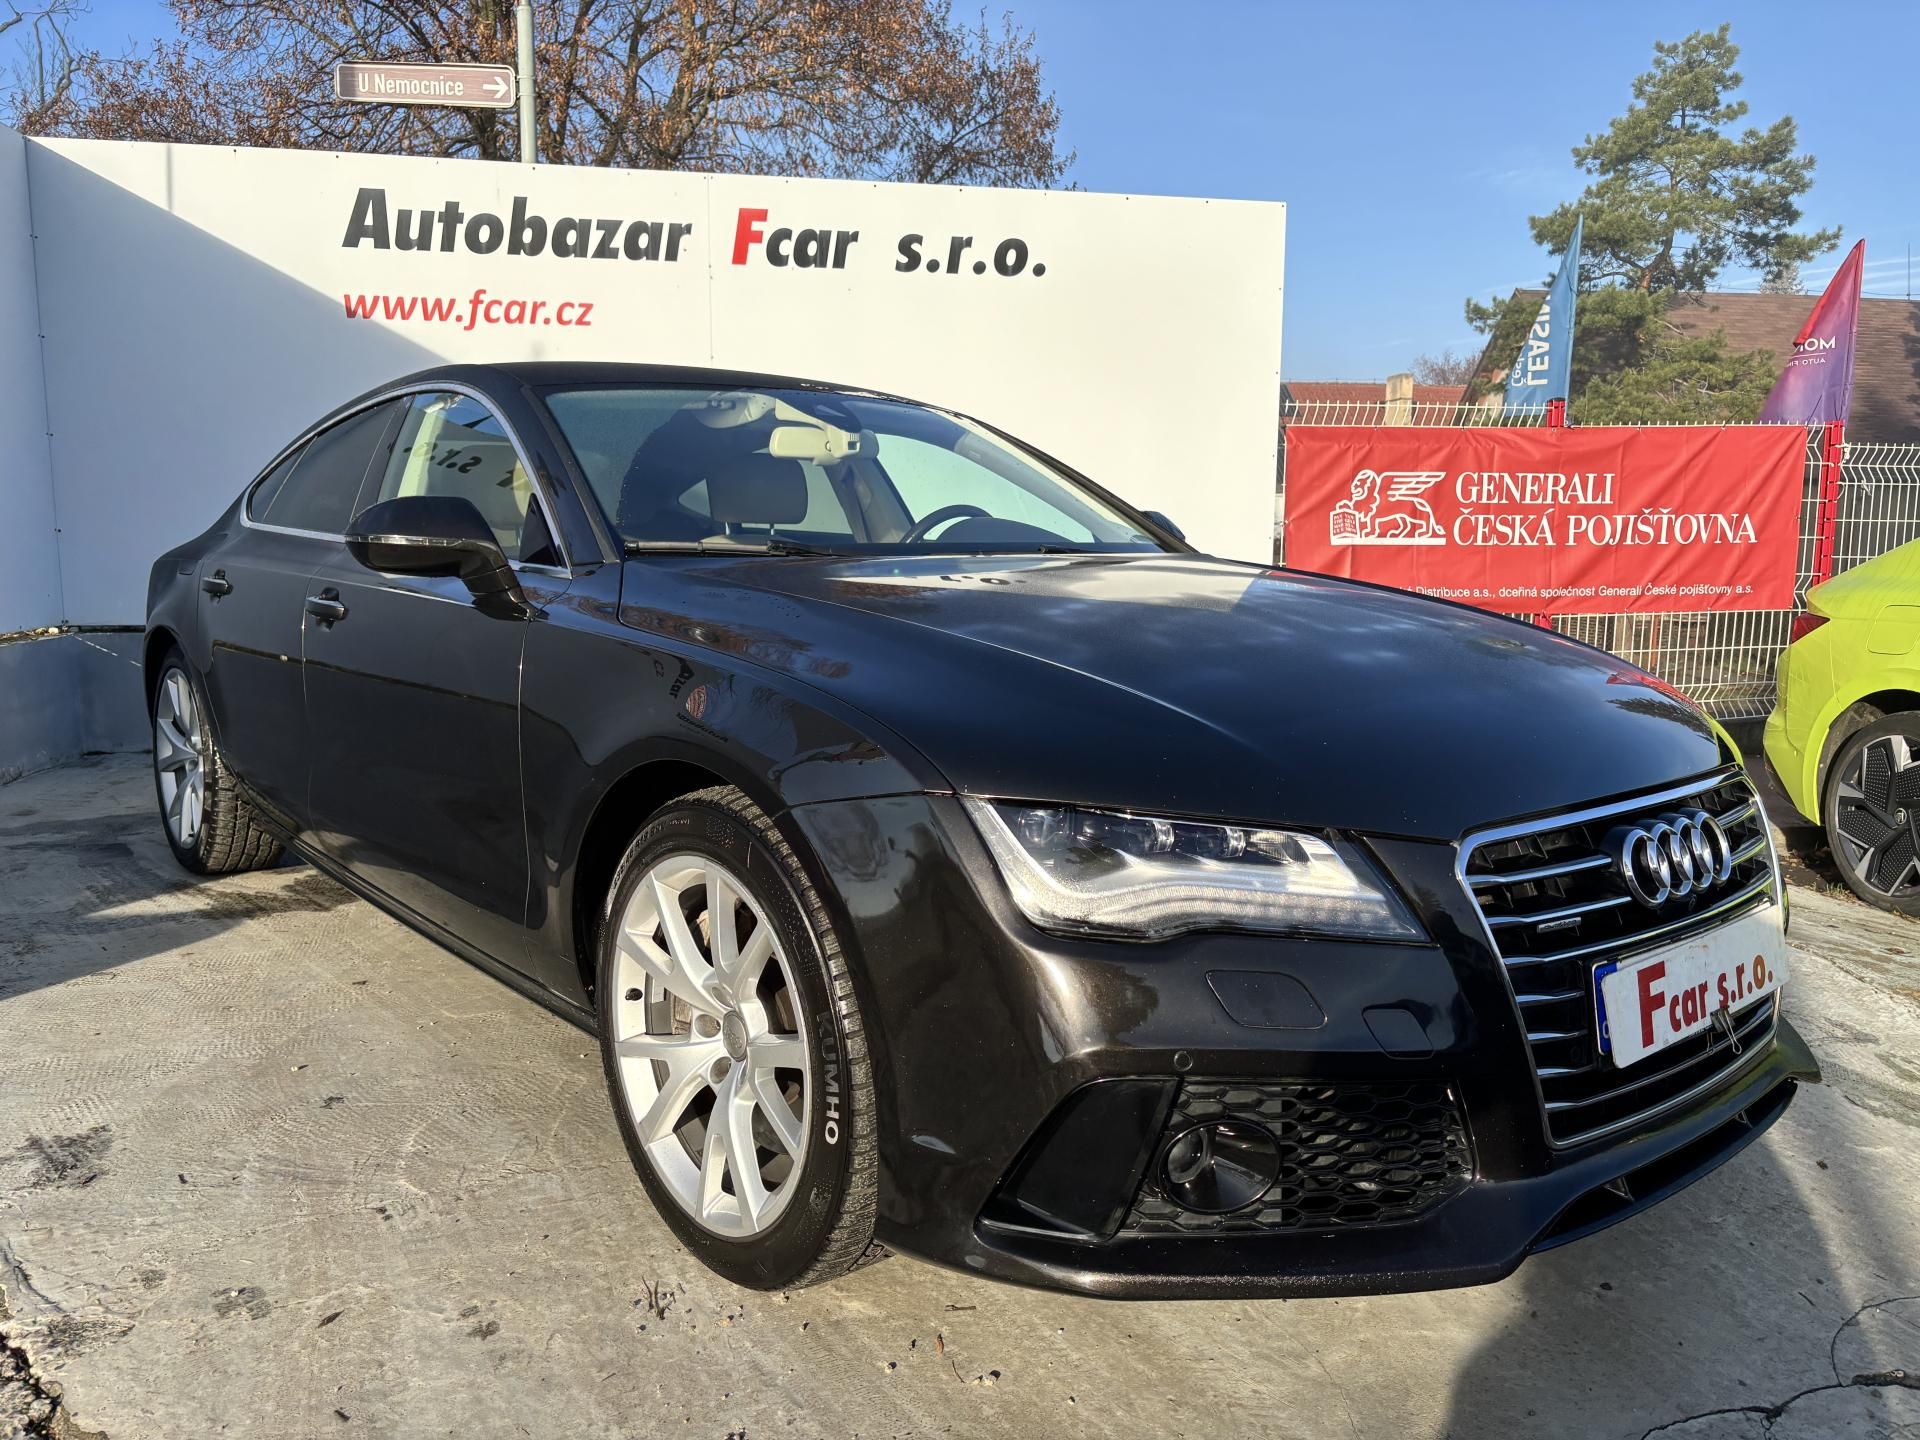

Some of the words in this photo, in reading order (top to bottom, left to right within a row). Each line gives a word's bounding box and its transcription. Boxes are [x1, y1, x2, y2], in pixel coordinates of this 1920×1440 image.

[358, 72, 369, 93] U
[374, 73, 464, 96] Nemocnice
[342, 187, 692, 262] Autobazar
[731, 207, 860, 270] Fcar
[895, 233, 1047, 278] s.r.o.
[343, 288, 595, 331] www.fcar.cz
[1455, 472, 1615, 504] GENERALI
[1453, 507, 1556, 546] ČESKÁ
[1565, 507, 1758, 546] POJIŠŤOVNA
[1416, 586, 1470, 598] Distribuce
[1499, 586, 1537, 598] dceřiná
[1540, 586, 1595, 600] společnost
[1599, 585, 1642, 597] Generali
[1645, 583, 1677, 596] České
[1679, 583, 1732, 597] pojišťovny
[1735, 584, 1754, 594] a.s.
[1637, 961, 1709, 1049] Fcar
[1717, 954, 1774, 1009] s.r.o.
[816, 1010, 840, 1145] KUMHO
